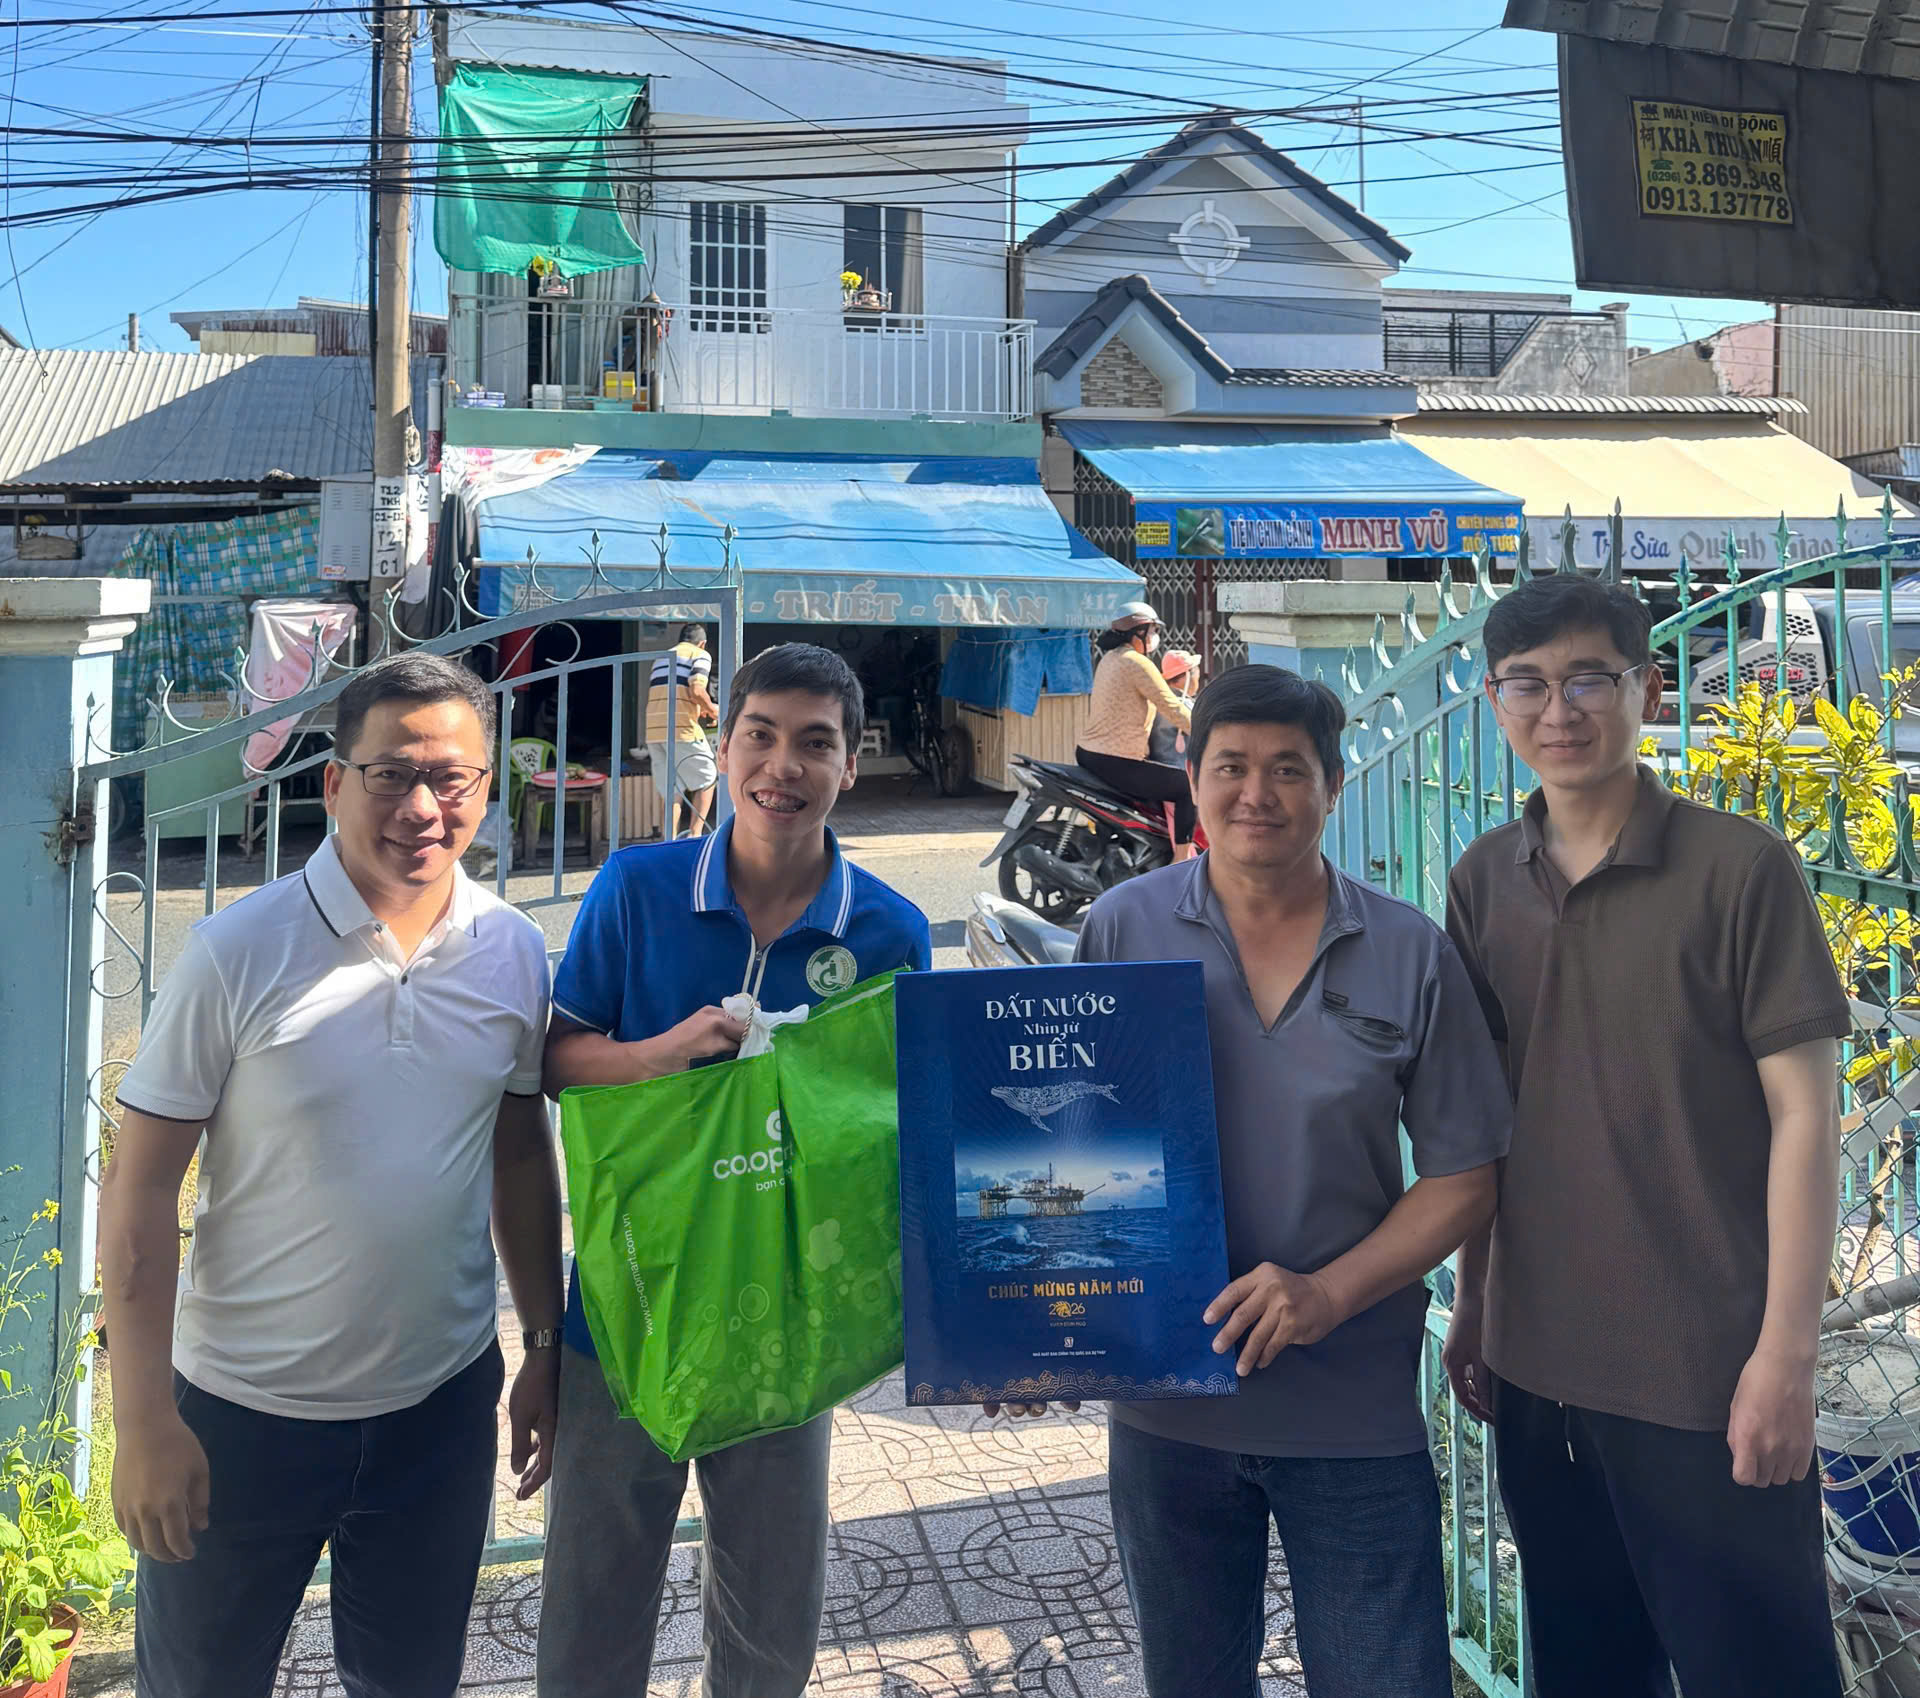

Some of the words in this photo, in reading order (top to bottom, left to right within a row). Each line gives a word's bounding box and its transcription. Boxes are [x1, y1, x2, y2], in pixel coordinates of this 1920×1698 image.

[1721, 116, 1734, 129] DI
[1737, 115, 1778, 133] ĐỘNG
[1683, 160, 1783, 194] 3.869.348
[1646, 186, 1789, 220] 0913.137778
[1256, 519, 1285, 549] CHIM
[1285, 509, 1315, 549] CẢNH
[1319, 516, 1404, 552] MINH
[1405, 508, 1449, 552] VŨ
[1592, 530, 1626, 559] Tr
[773, 579, 904, 622] TRIẾT
[985, 992, 1036, 1020] ĐẤT
[1042, 991, 1117, 1017] NƯỚC
[1023, 1021, 1060, 1036] Nhìn
[1063, 1020, 1080, 1035] từ
[1008, 1032, 1097, 1071] BIỂN
[987, 1281, 1029, 1300] CHÚC
[1033, 1280, 1076, 1298] MỪNG
[1079, 1278, 1113, 1297] NĂM
[1117, 1276, 1145, 1295] MỚI
